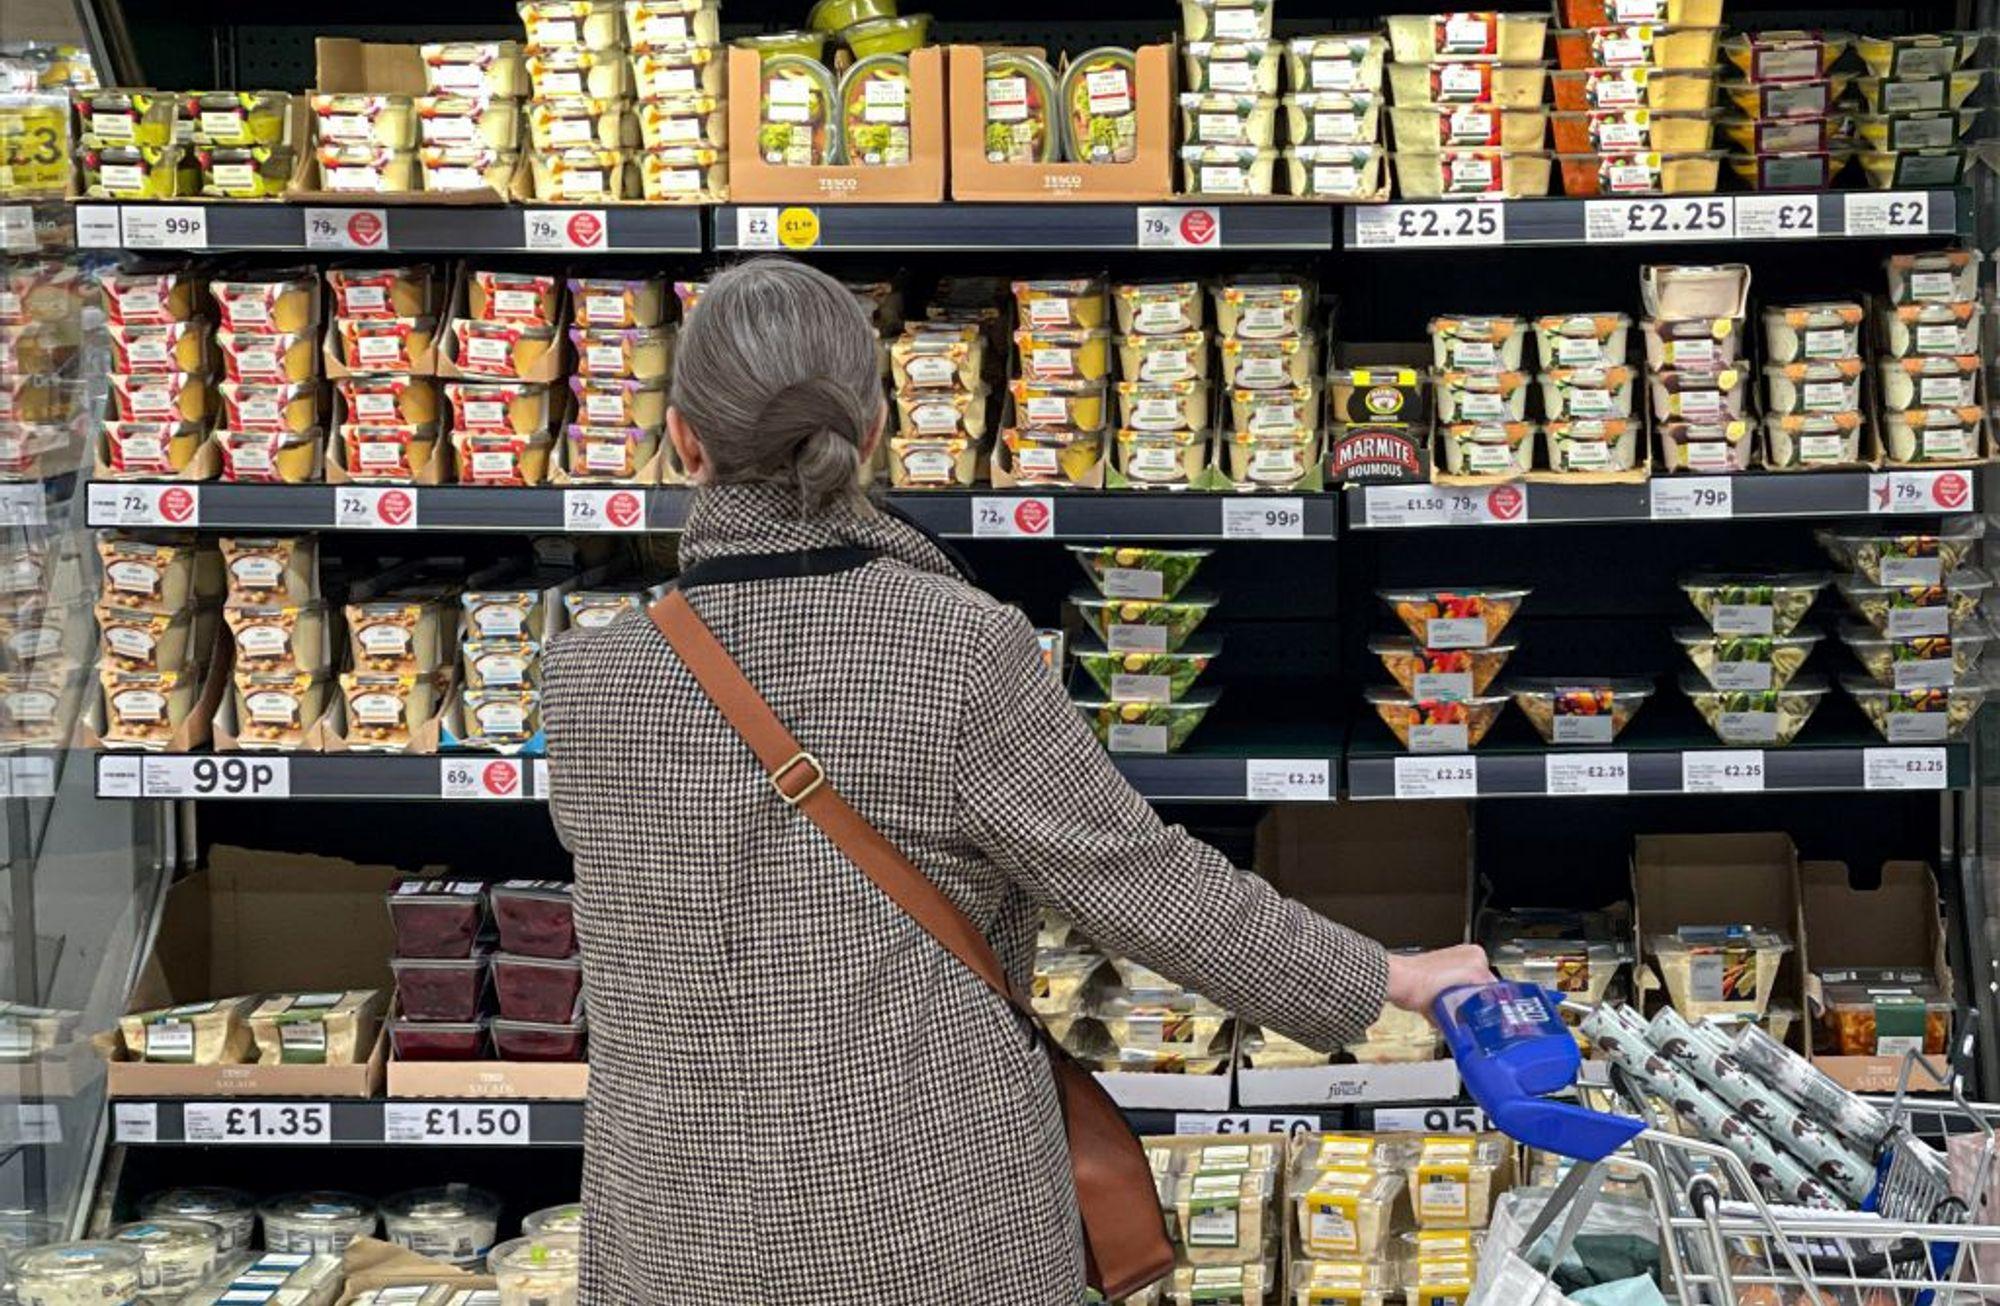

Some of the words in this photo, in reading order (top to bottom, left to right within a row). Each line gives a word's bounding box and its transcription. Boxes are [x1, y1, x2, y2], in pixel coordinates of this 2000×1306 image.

[1398, 208, 1497, 237] £2.25
[1627, 202, 1727, 232] £2.25
[1778, 205, 1814, 230] £2
[1888, 202, 1924, 226] £2
[166, 217, 200, 234] 99p
[312, 218, 338, 236] 79p
[532, 221, 558, 238] 79p
[749, 219, 768, 234] £2
[1145, 219, 1170, 236] 79p
[1339, 438, 1411, 465] MARMITE
[1347, 463, 1403, 478] HOUMOUS
[1693, 489, 1728, 506] 79p
[1896, 484, 1923, 499] 79p
[123, 496, 149, 514] 72p
[343, 498, 367, 515] 72p
[571, 502, 597, 519] 72p
[1407, 499, 1444, 511] £1.50
[1452, 496, 1478, 513] 79p
[980, 509, 1005, 526] 72p
[1266, 510, 1300, 527] 99p
[1436, 768, 1474, 780] £2.25
[1587, 766, 1625, 778] £2.25
[1724, 764, 1764, 777] £2.25
[1906, 760, 1944, 772] £2.25
[193, 758, 273, 793] 99p
[447, 769, 475, 785] 69p
[1287, 773, 1326, 785] £2.25
[225, 1107, 324, 1136] £1.35
[425, 1107, 522, 1135] £1.50
[1217, 1118, 1312, 1137] £150
